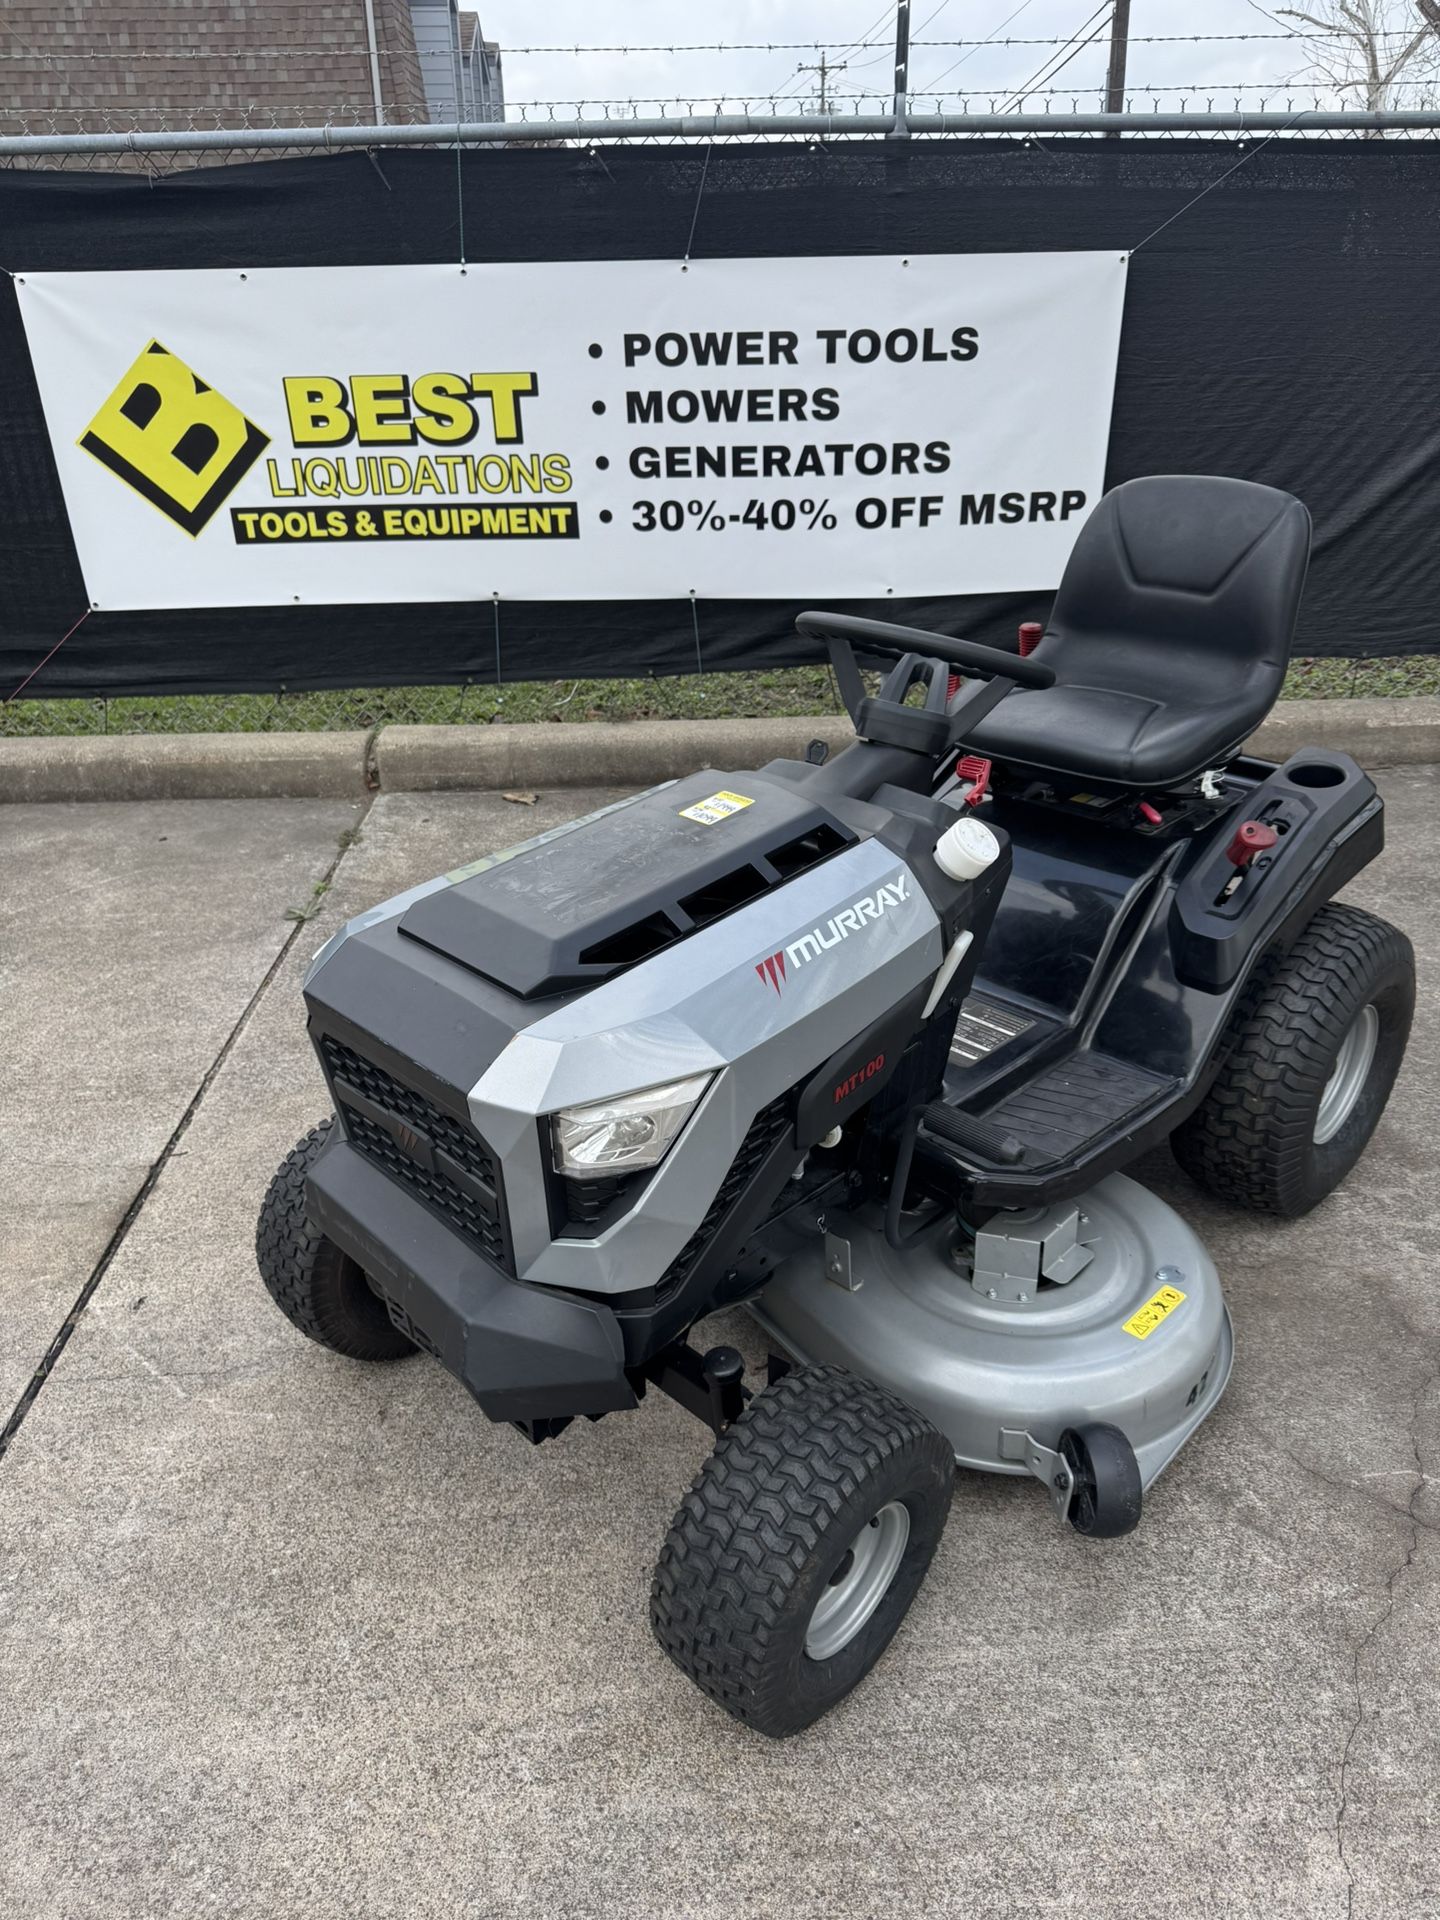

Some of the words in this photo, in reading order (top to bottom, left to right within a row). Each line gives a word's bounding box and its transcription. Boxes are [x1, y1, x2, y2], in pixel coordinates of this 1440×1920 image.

[623, 331, 799, 367] POWER
[816, 326, 979, 364] TOOLS
[283, 372, 538, 447] BEST
[625, 388, 840, 424] MOWERS
[267, 454, 573, 499] LIQUIDATIONS
[629, 441, 951, 479] GENERATORS
[237, 511, 348, 539] TOOLS
[354, 511, 378, 537] &
[383, 507, 571, 537] EQUIPMENT
[632, 499, 838, 532] 30%-40%
[855, 495, 944, 529] OFF
[959, 490, 1087, 526] MSRP
[833, 1054, 885, 1104] MT100
